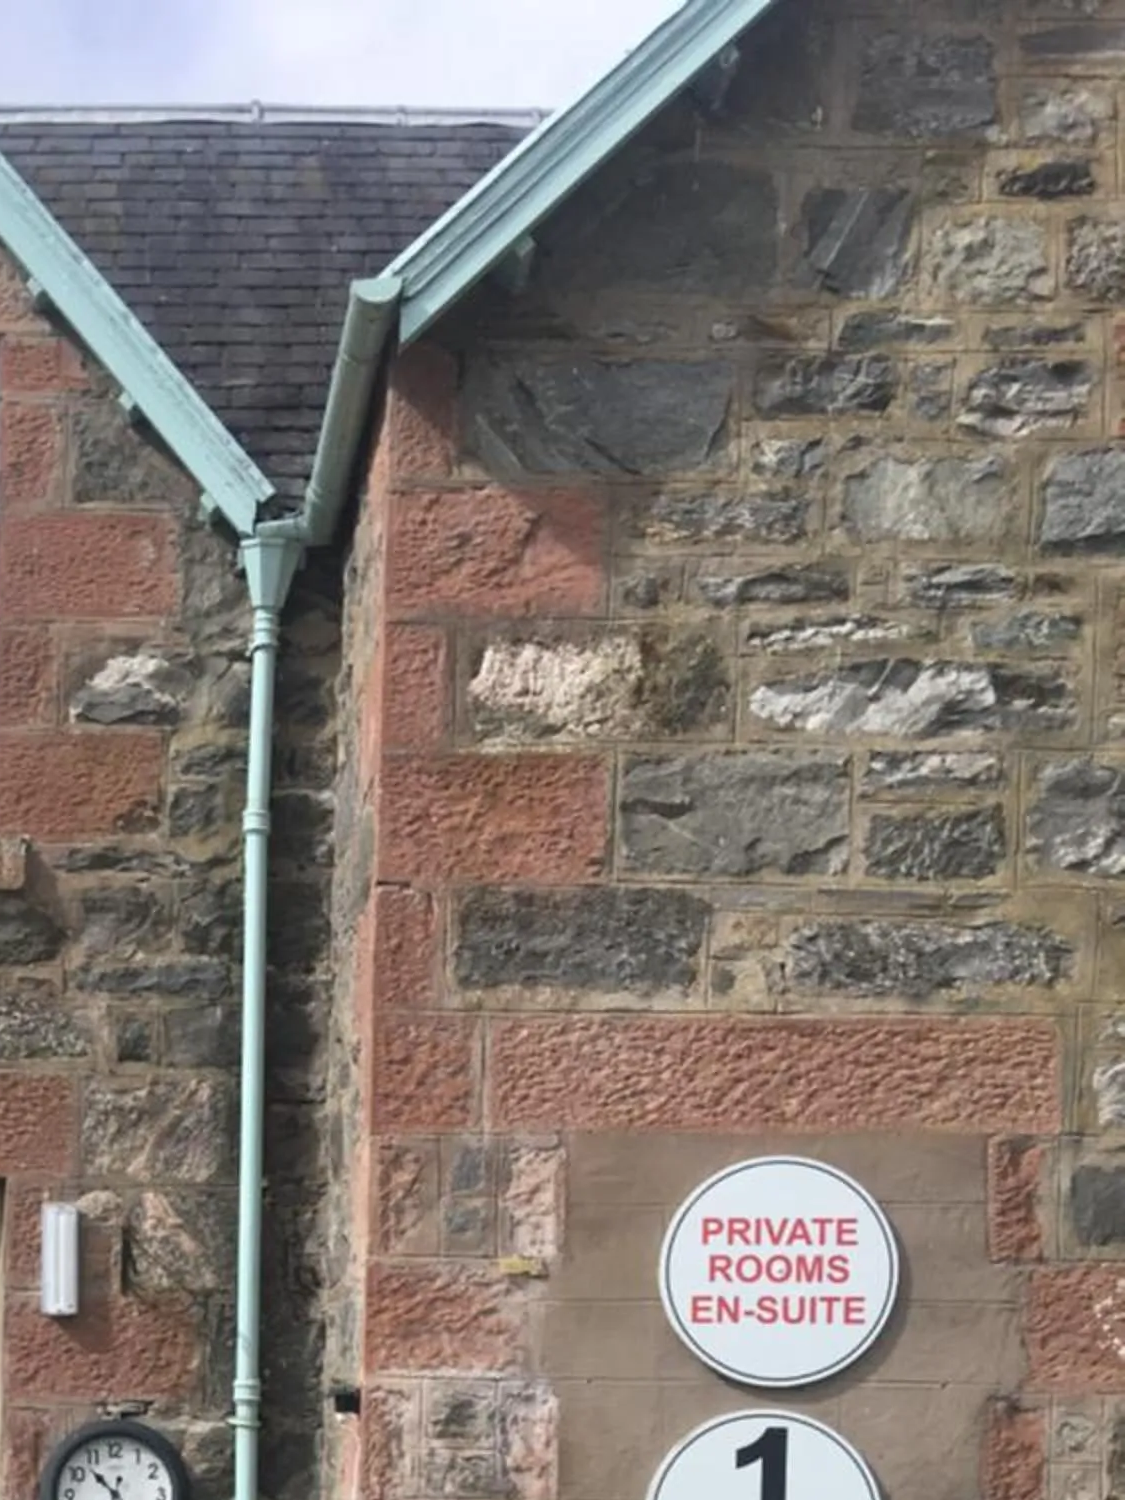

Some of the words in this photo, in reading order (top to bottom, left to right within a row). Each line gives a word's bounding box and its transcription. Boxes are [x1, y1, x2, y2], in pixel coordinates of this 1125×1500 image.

[702, 1218, 859, 1247] PRIVATE
[709, 1255, 851, 1284] ROOMS
[691, 1296, 866, 1325] EN-SUITE
[86, 1448, 100, 1465] 11
[106, 1441, 123, 1459] 12
[135, 1448, 141, 1465] 1
[69, 1466, 86, 1482] 10
[148, 1462, 159, 1480] 2
